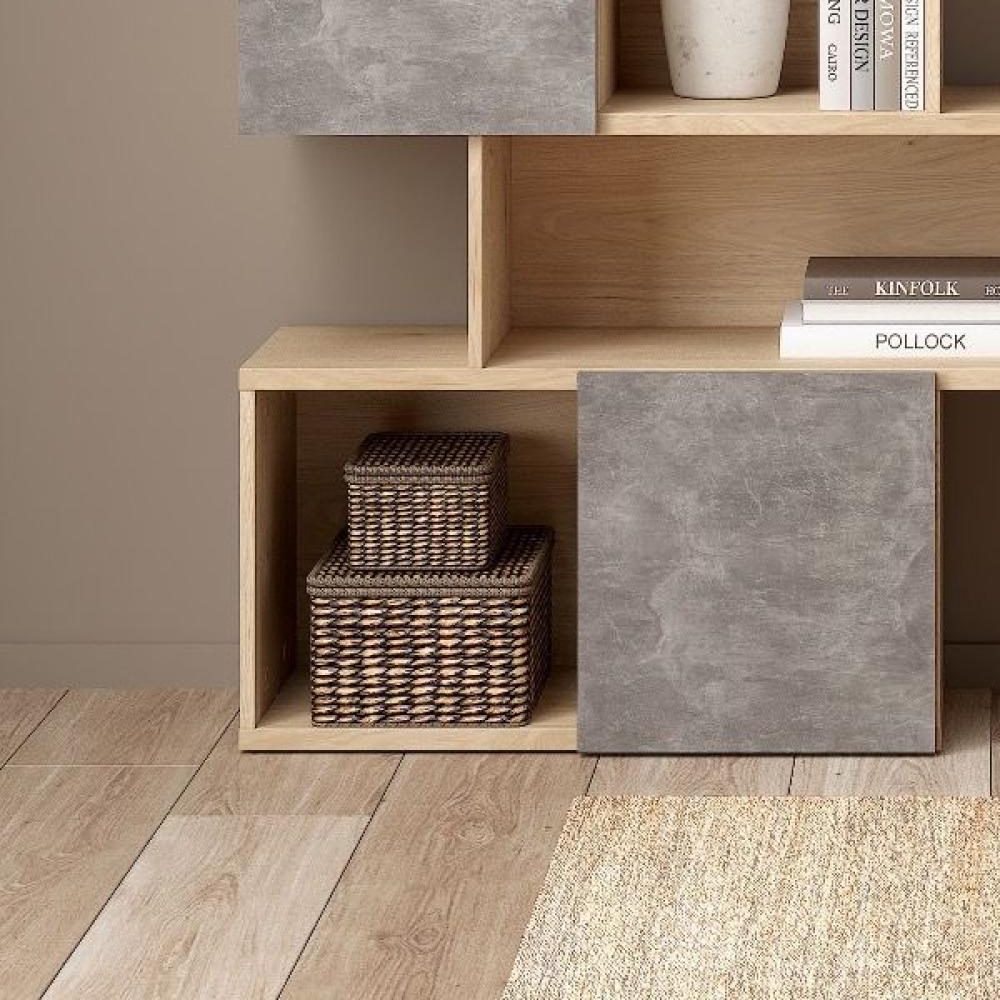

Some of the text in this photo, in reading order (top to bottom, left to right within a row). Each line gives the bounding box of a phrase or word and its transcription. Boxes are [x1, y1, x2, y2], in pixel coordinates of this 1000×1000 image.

[854, 9, 869, 71] DESIGN
[904, 31, 919, 110] REFERENCED
[827, 286, 849, 296] THE
[874, 280, 960, 296] KINFOLK
[876, 333, 966, 350] POLLOCK
